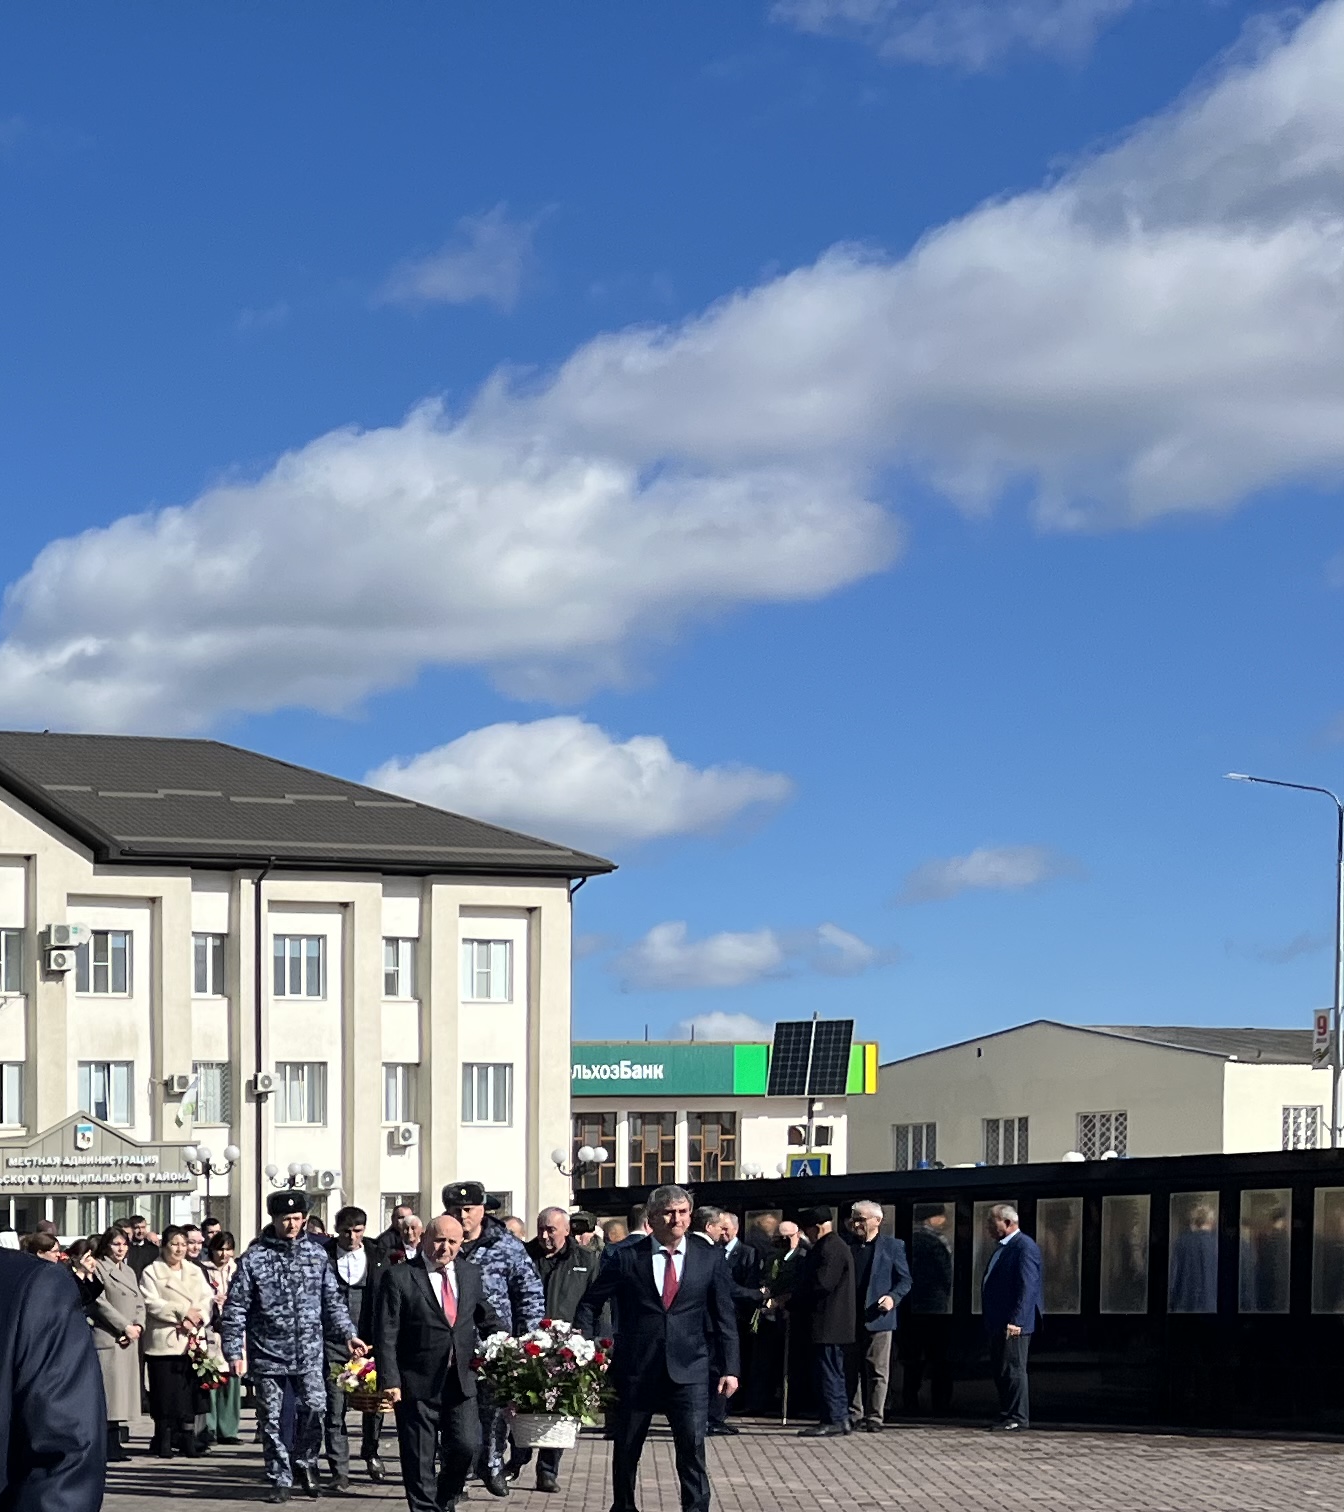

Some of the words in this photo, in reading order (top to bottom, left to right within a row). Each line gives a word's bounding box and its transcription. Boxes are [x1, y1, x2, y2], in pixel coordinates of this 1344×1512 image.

[1317, 1015, 1327, 1036] 9
[570, 1059, 664, 1080] льхозБанк
[7, 1156, 61, 1167] МЕСТНАЯ
[62, 1155, 160, 1167] АДМИНИСТРАЦИЯ
[41, 1172, 145, 1185] МУНИЦИПАЛЬНОГО
[149, 1171, 193, 1182] РАЙОНА
